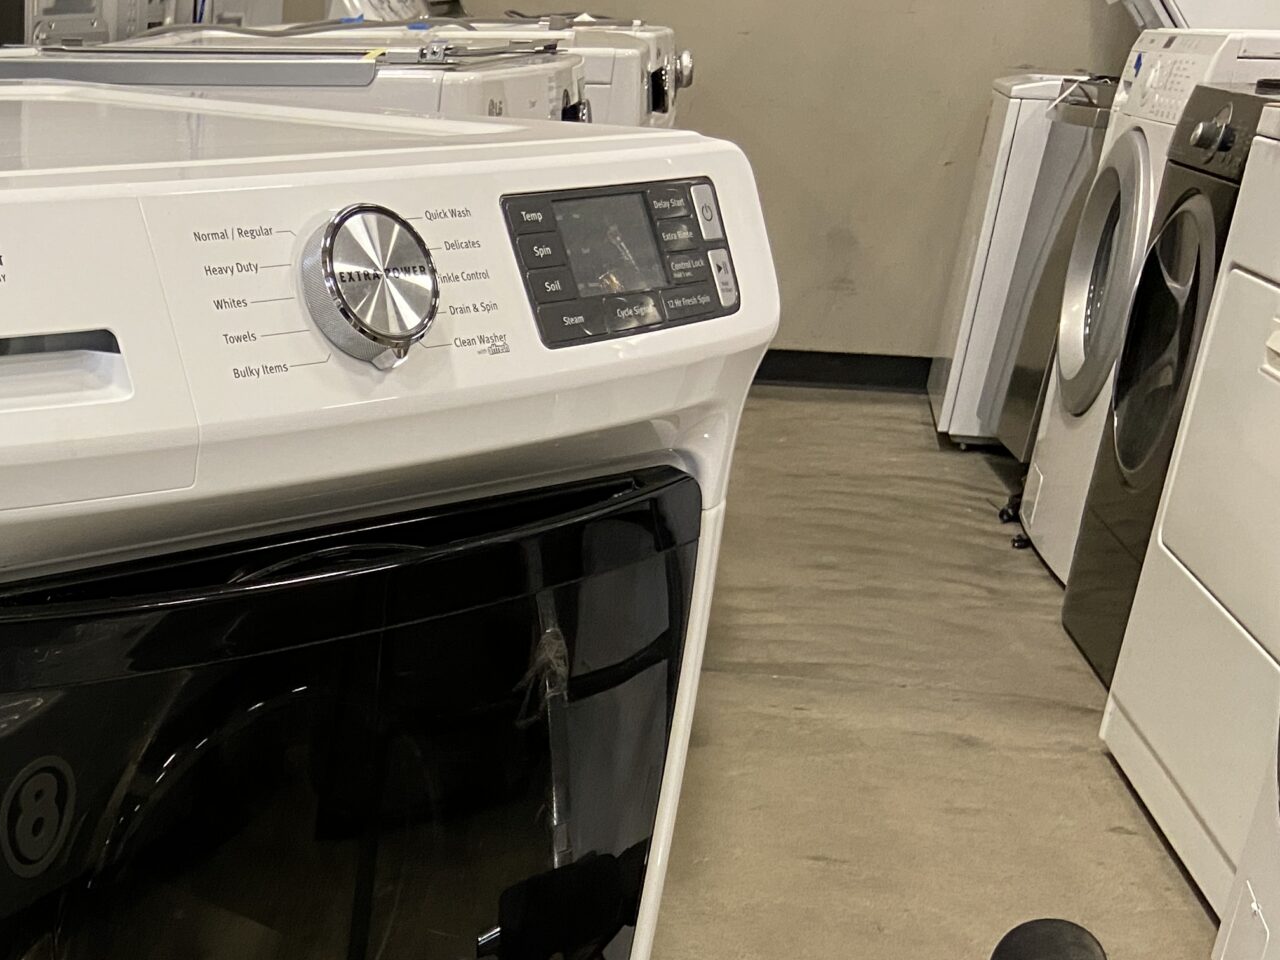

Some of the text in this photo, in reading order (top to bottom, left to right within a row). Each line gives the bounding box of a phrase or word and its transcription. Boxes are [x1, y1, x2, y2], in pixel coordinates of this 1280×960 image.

[653, 198, 685, 209] Delay Start
[425, 207, 472, 221] Quick Wash
[521, 211, 543, 222] Temp
[193, 229, 229, 242] Normal
[237, 225, 273, 240] Regular
[662, 231, 677, 241] Extra
[444, 240, 481, 252] Delicates
[533, 245, 552, 258] Spin
[204, 261, 259, 276] Heavy Duty
[670, 259, 704, 271] Control Lock
[339, 265, 426, 283] EXTRA POWER
[438, 269, 490, 284] inkle Control
[545, 281, 561, 292] Soil
[213, 297, 248, 310] Whites
[682, 297, 697, 306] Fresh
[698, 295, 711, 304] Spin
[449, 300, 498, 315] Drain & Spin
[616, 307, 634, 319] Cycle
[562, 314, 584, 327] Steam
[223, 331, 257, 345] Towels
[454, 332, 506, 347] Clean Washer
[233, 363, 289, 379] Bulky Items
